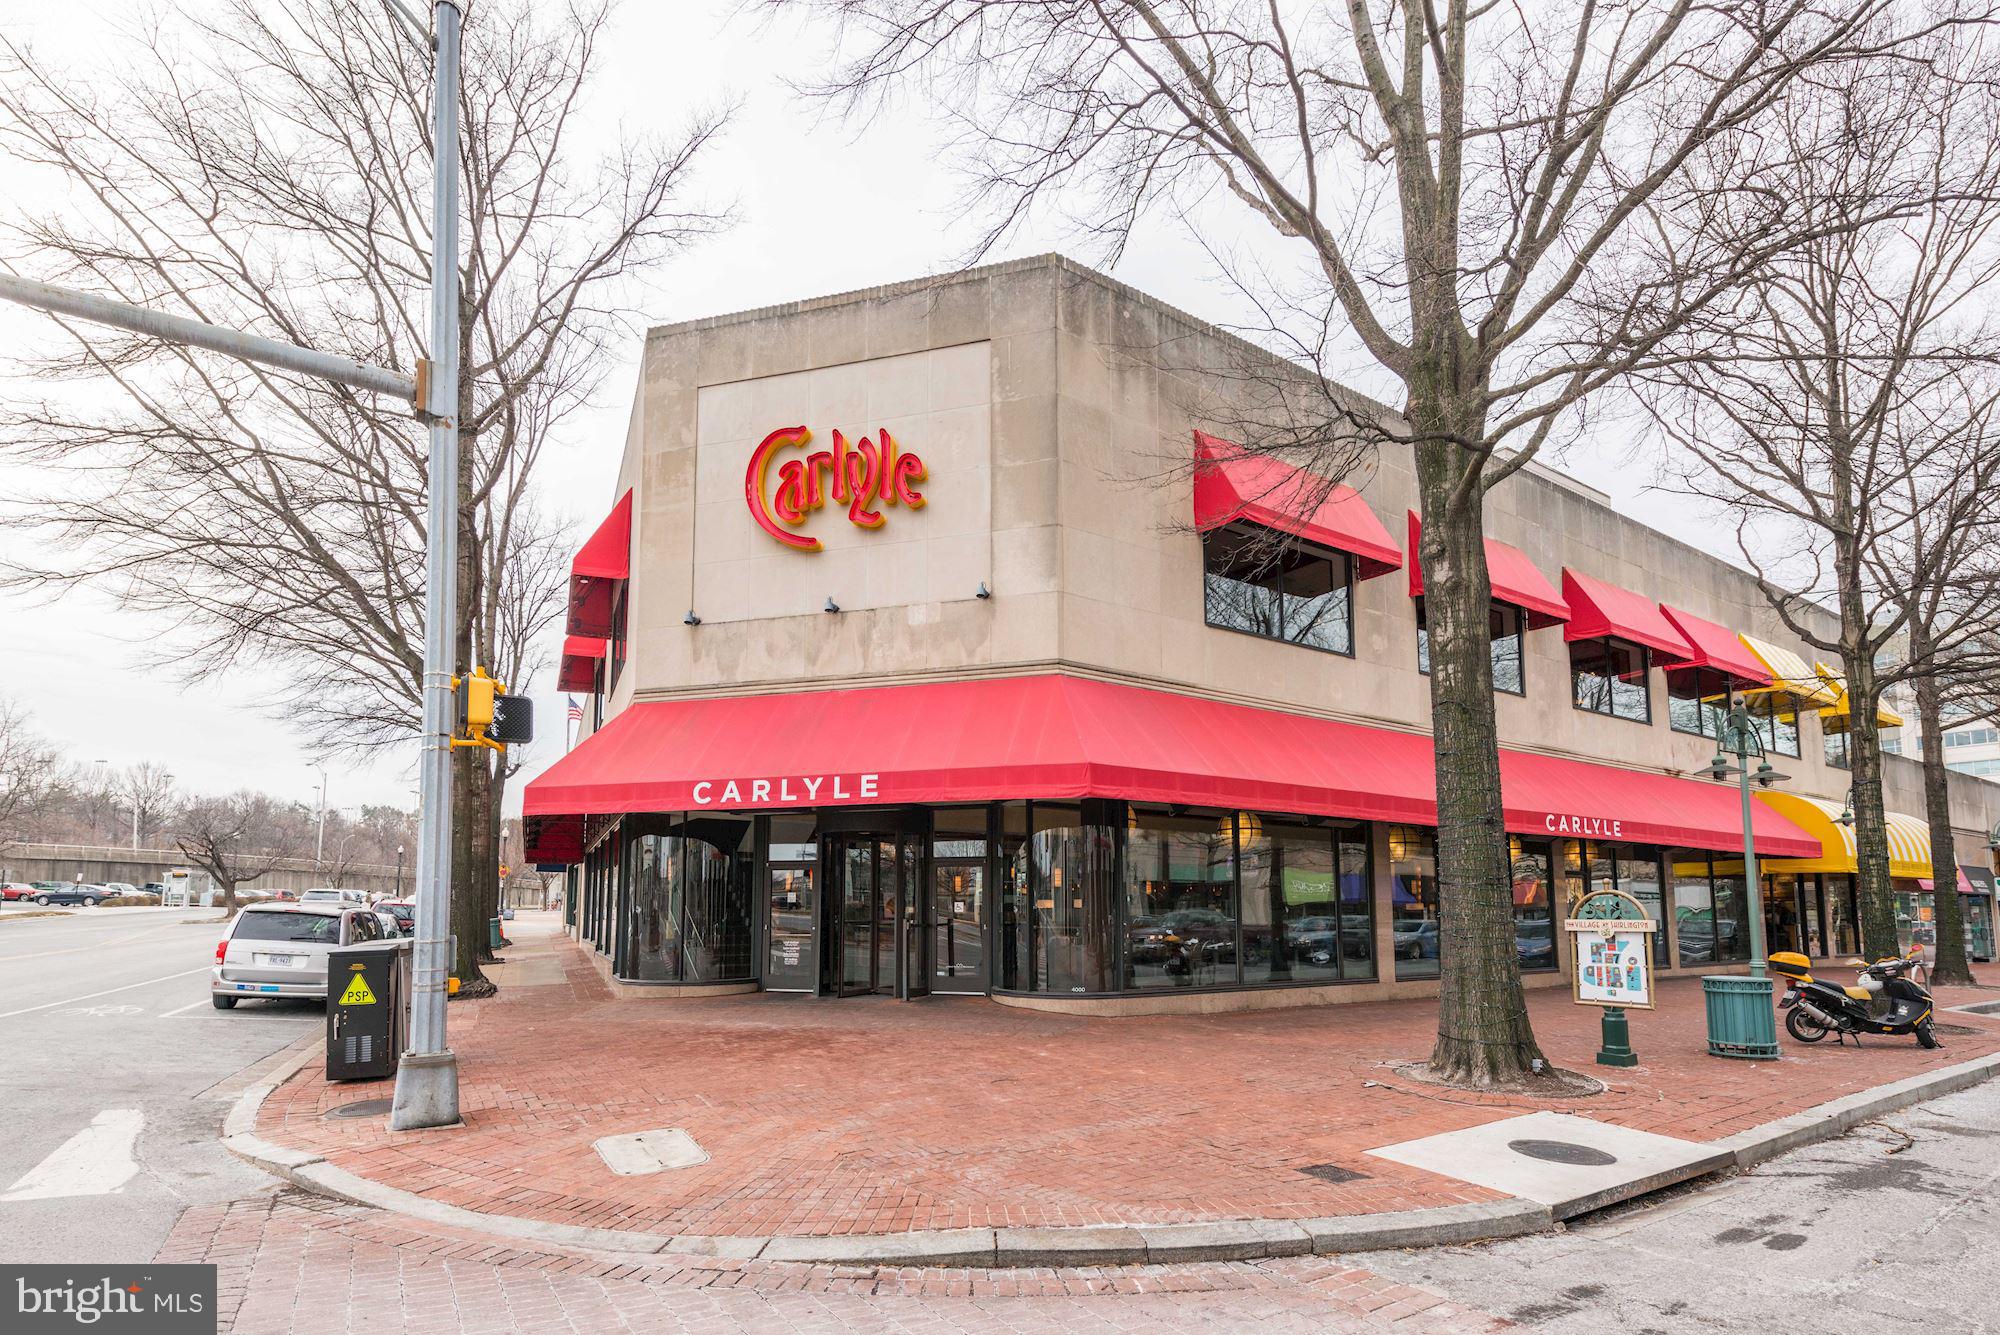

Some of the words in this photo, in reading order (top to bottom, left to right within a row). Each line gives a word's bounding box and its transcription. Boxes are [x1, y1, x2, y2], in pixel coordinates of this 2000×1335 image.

[745, 425, 929, 552] Carlyle
[692, 774, 879, 804] CARLYLE
[1545, 814, 1622, 837] CARLYLE
[1575, 921, 1600, 929] VILLAGE
[1610, 921, 1649, 929] SHIRLINGTON
[347, 991, 369, 1002] PSP
